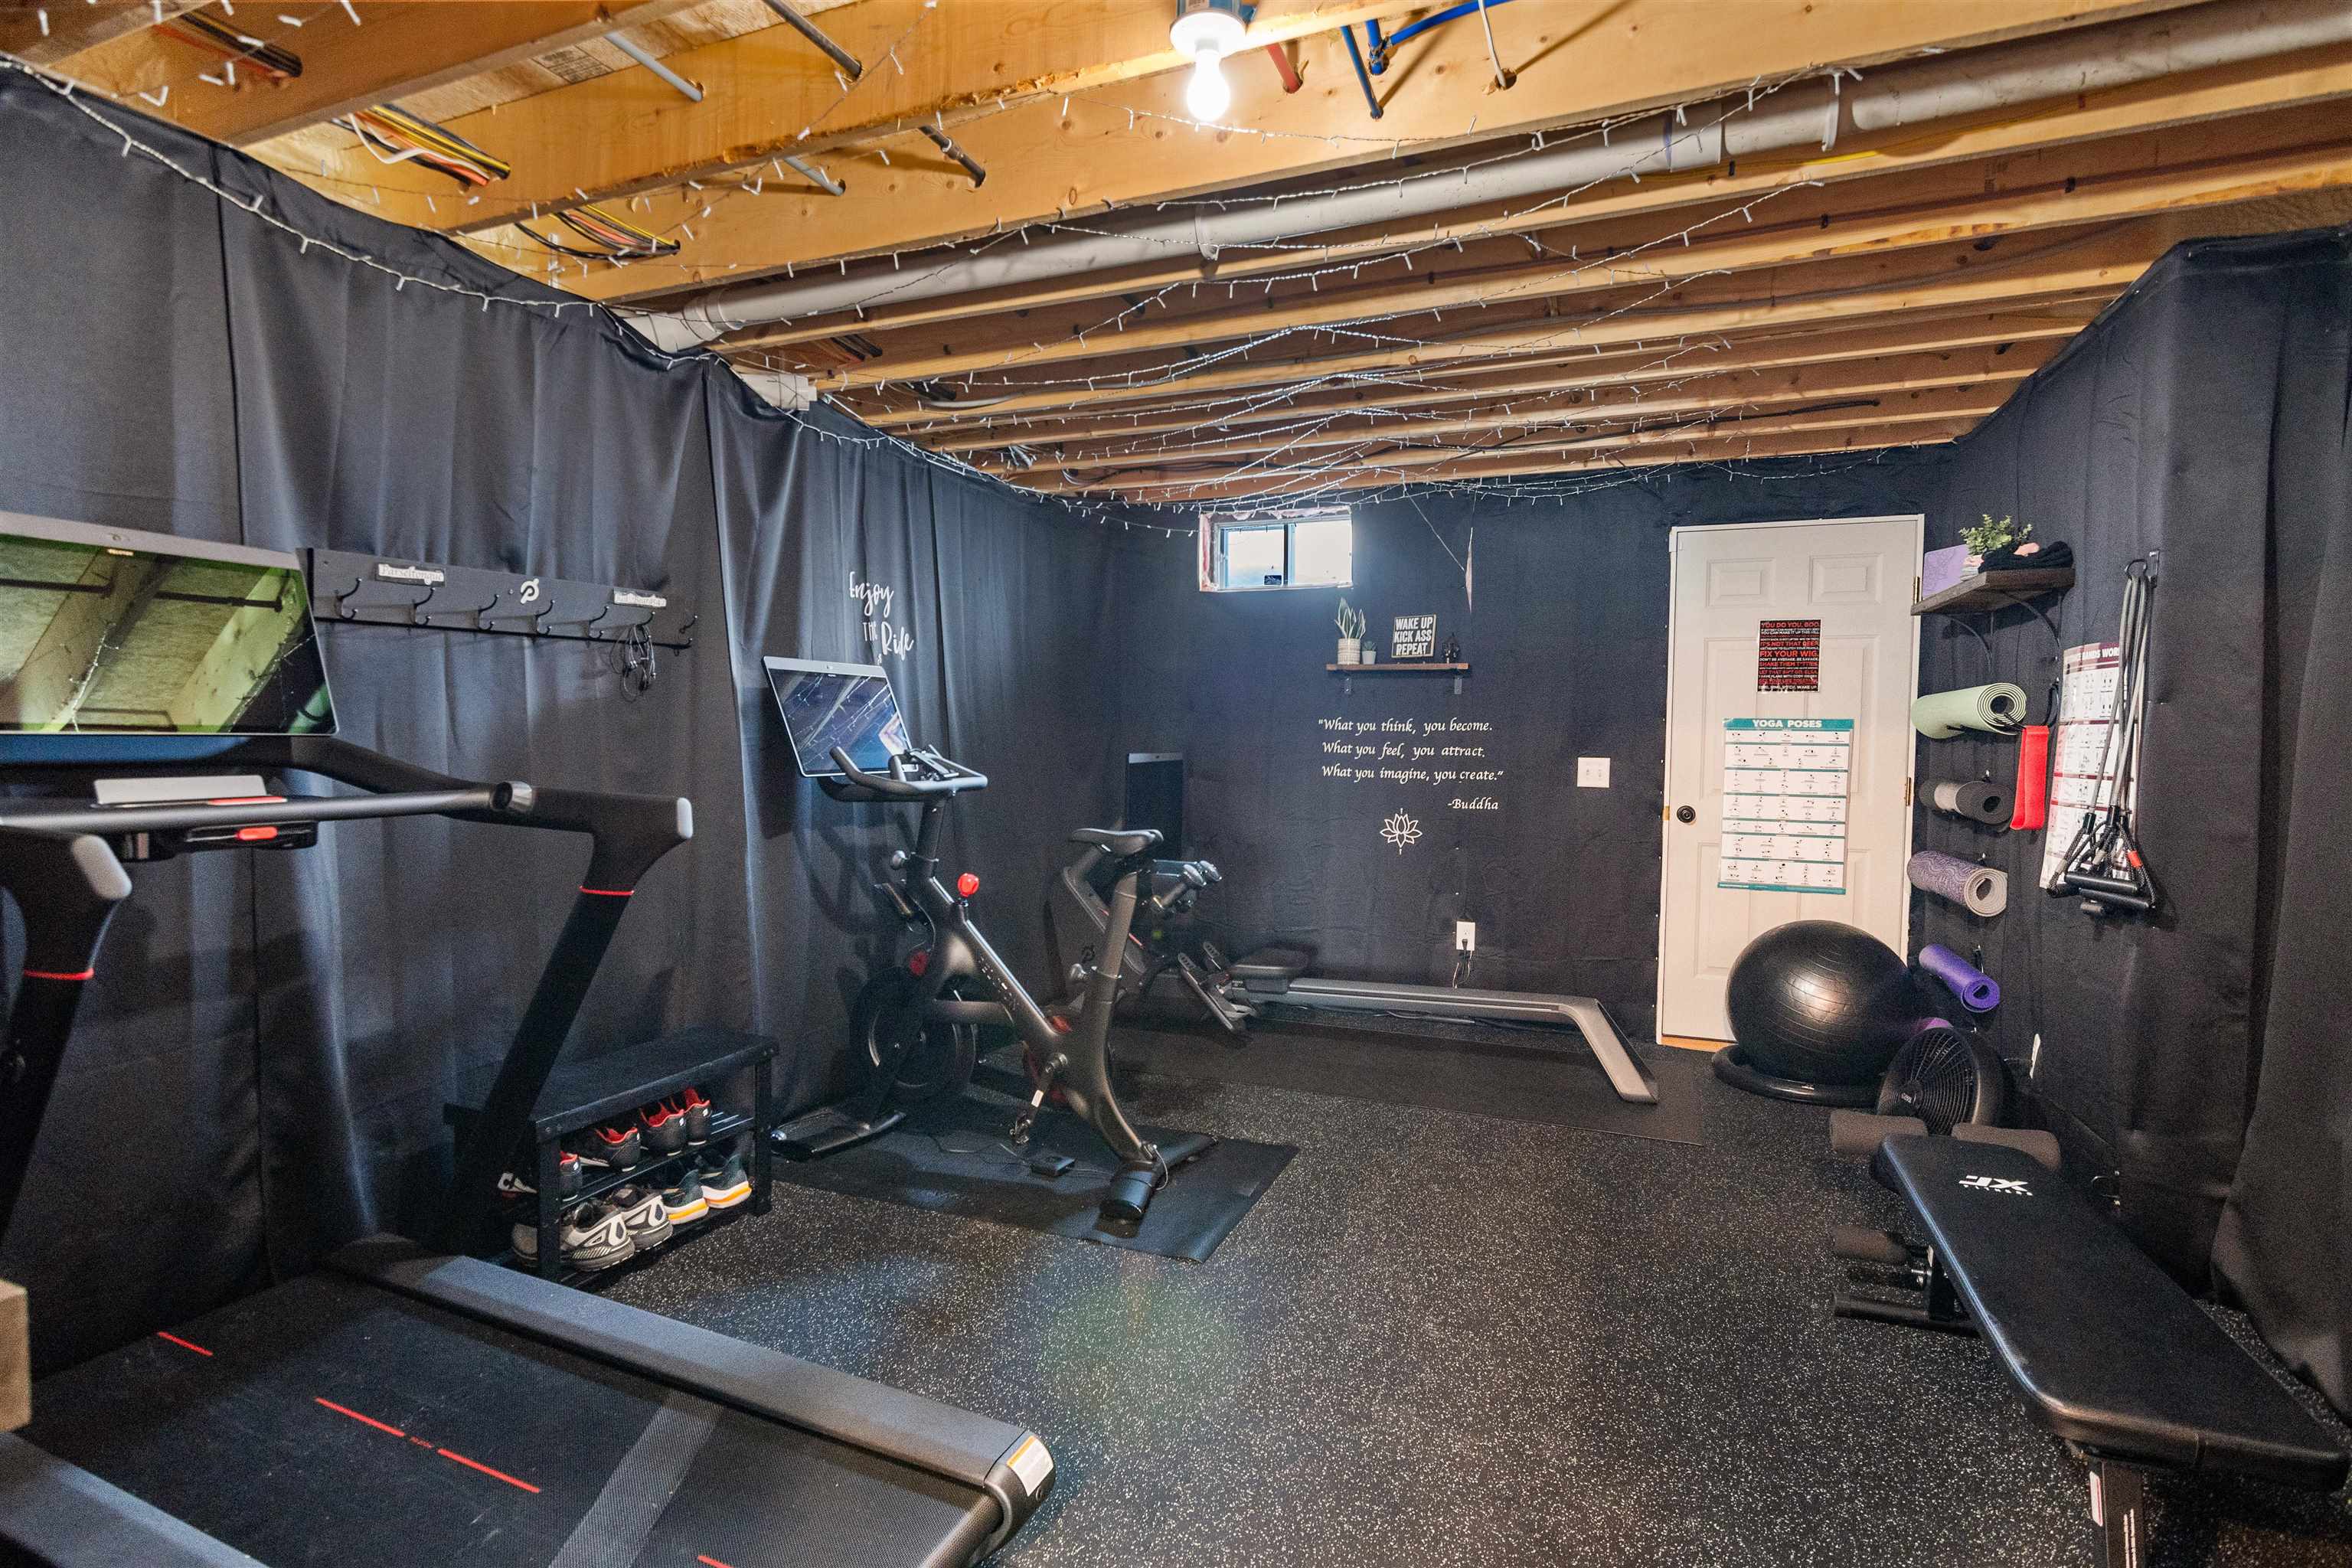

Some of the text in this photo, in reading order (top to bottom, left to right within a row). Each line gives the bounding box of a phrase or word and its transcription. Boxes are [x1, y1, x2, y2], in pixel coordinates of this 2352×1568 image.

[848, 571, 894, 618] Enjoy
[1396, 616, 1433, 631] WAKE UP
[863, 620, 914, 662] THE Ride
[1393, 629, 1432, 643] KICK ASS
[1396, 642, 1428, 656] REPEAT
[1318, 717, 1493, 737] "What you think, you become.
[1752, 719, 1823, 728] YOGA POSES
[1322, 740, 1485, 761] What you feel, you attract.
[1322, 763, 1352, 778] What
[1353, 769, 1375, 783] you
[1379, 766, 1430, 785] imagine,
[1432, 771, 1457, 786] you
[1447, 796, 1499, 810] -Buddha
